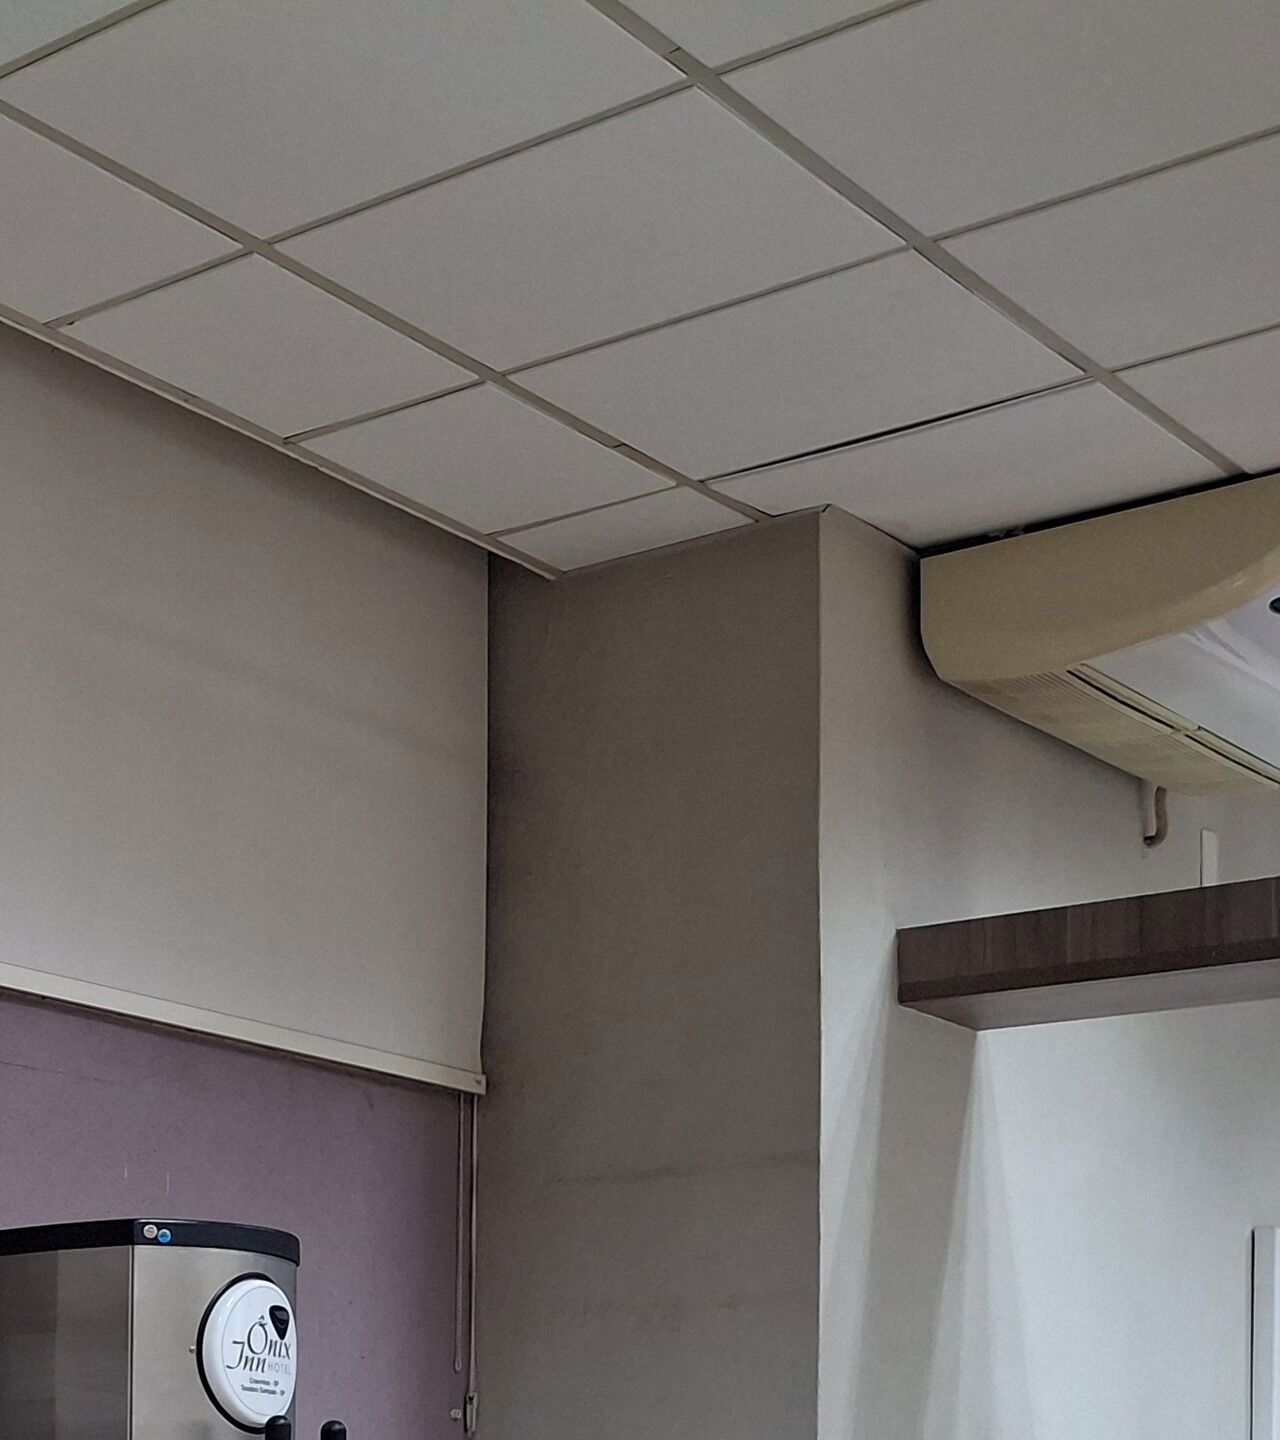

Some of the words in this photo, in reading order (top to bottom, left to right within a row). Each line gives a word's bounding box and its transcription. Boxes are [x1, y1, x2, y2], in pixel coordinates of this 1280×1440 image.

[226, 1340, 267, 1373] Inn
[268, 1362, 291, 1376] HOTEL
[247, 1314, 291, 1361] Ônix
